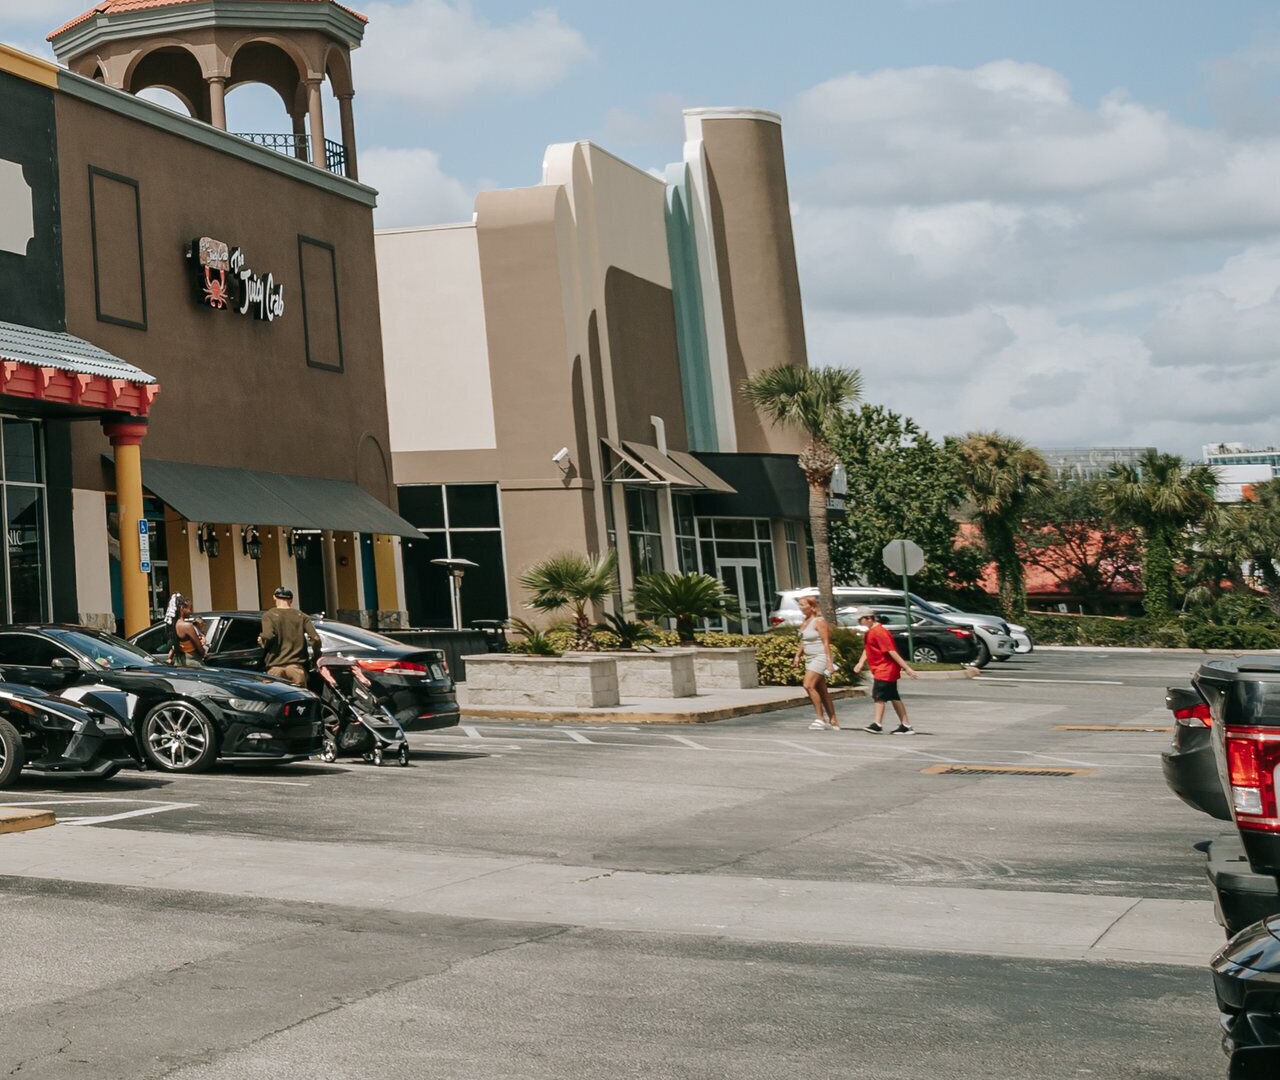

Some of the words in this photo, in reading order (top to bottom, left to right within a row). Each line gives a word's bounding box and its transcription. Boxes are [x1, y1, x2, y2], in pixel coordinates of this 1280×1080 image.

[230, 247, 245, 274] The
[240, 269, 264, 319] Juicy
[266, 272, 284, 322] Crab
